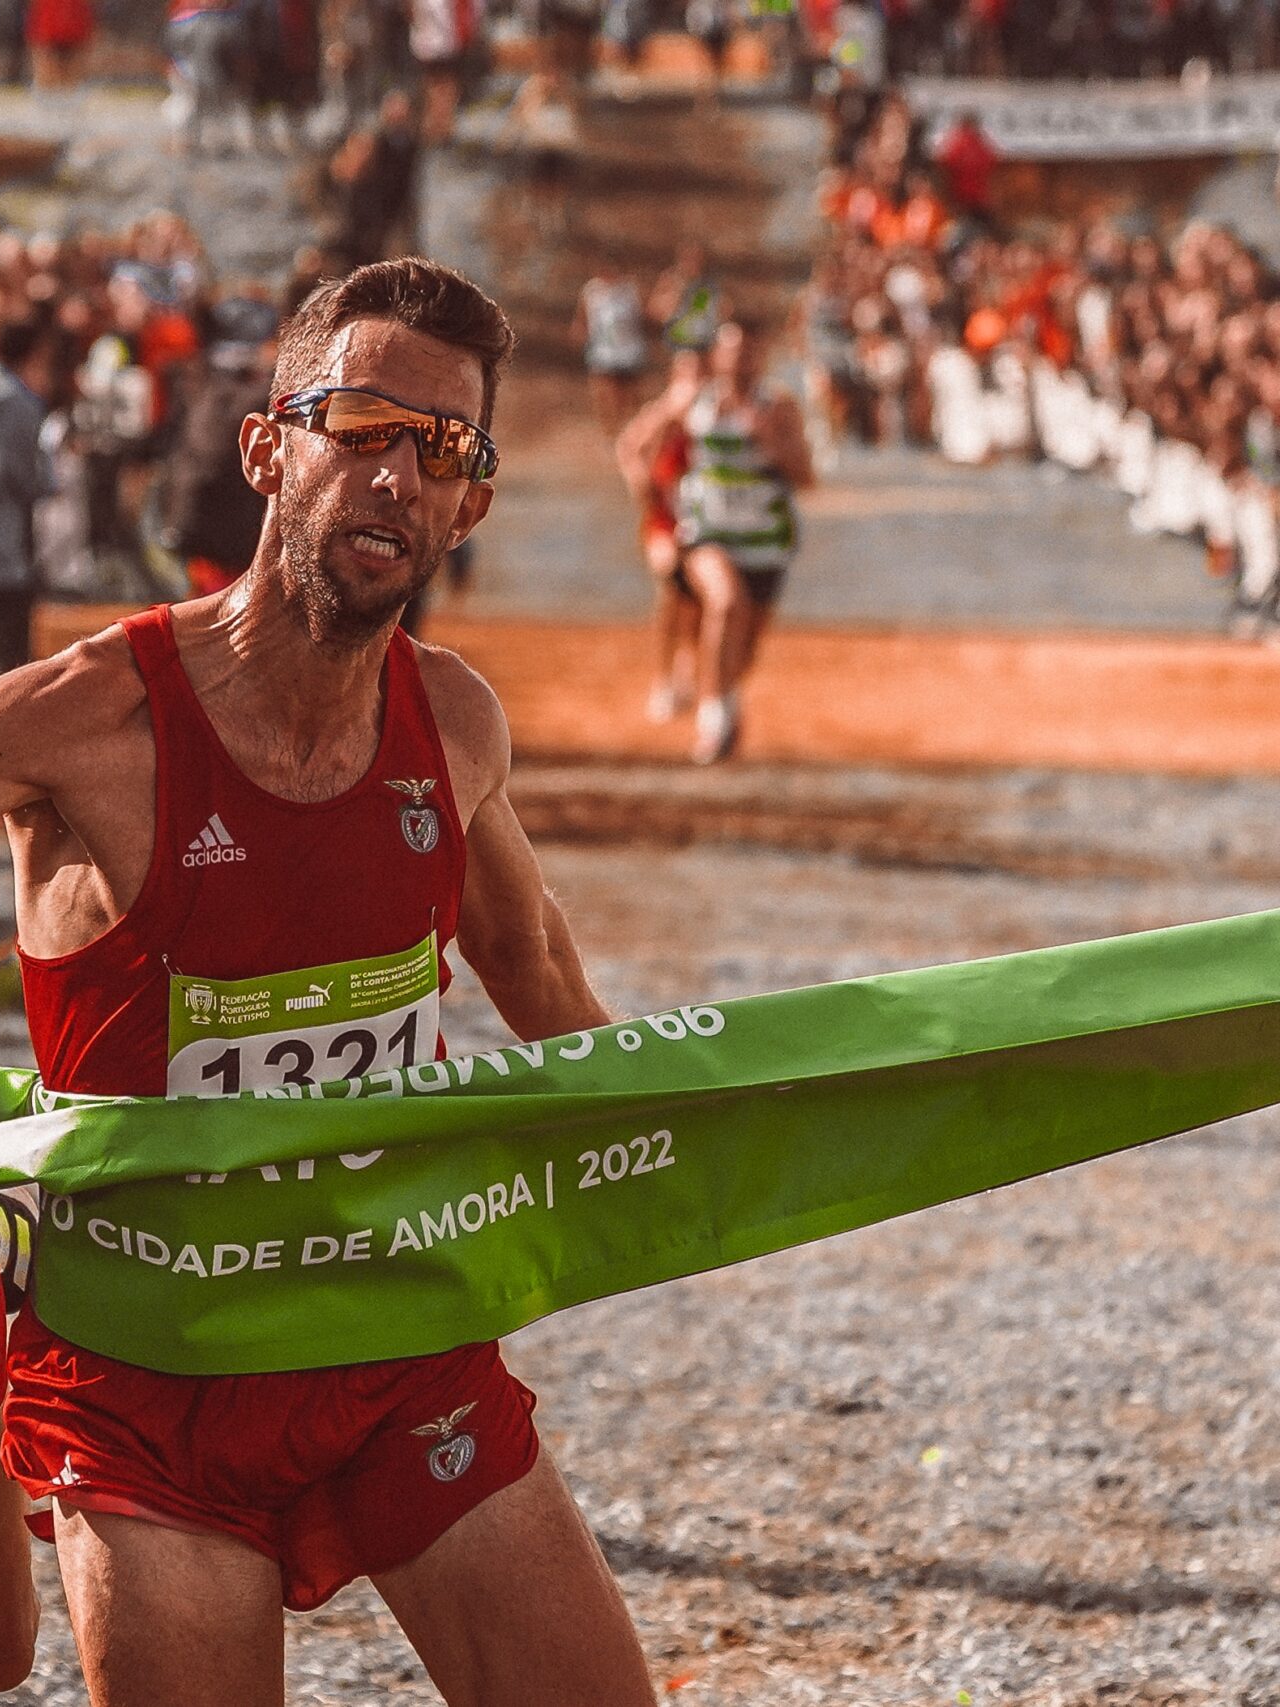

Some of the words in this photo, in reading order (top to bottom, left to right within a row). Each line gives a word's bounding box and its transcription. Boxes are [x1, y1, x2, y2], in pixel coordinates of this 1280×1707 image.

[182, 845, 248, 868] adidas
[350, 981, 362, 989] DE
[220, 990, 271, 1004] FEDERAÇÃO
[285, 994, 324, 1012] PUMA
[220, 1001, 271, 1014] PORTUGUESA
[218, 1010, 271, 1025] ATLETISMO
[201, 1009, 418, 1095] 1321
[86, 1218, 285, 1278] CIDADE
[300, 1227, 373, 1266] DE
[387, 1172, 536, 1257] AMORA
[577, 1128, 676, 1190] 2022
